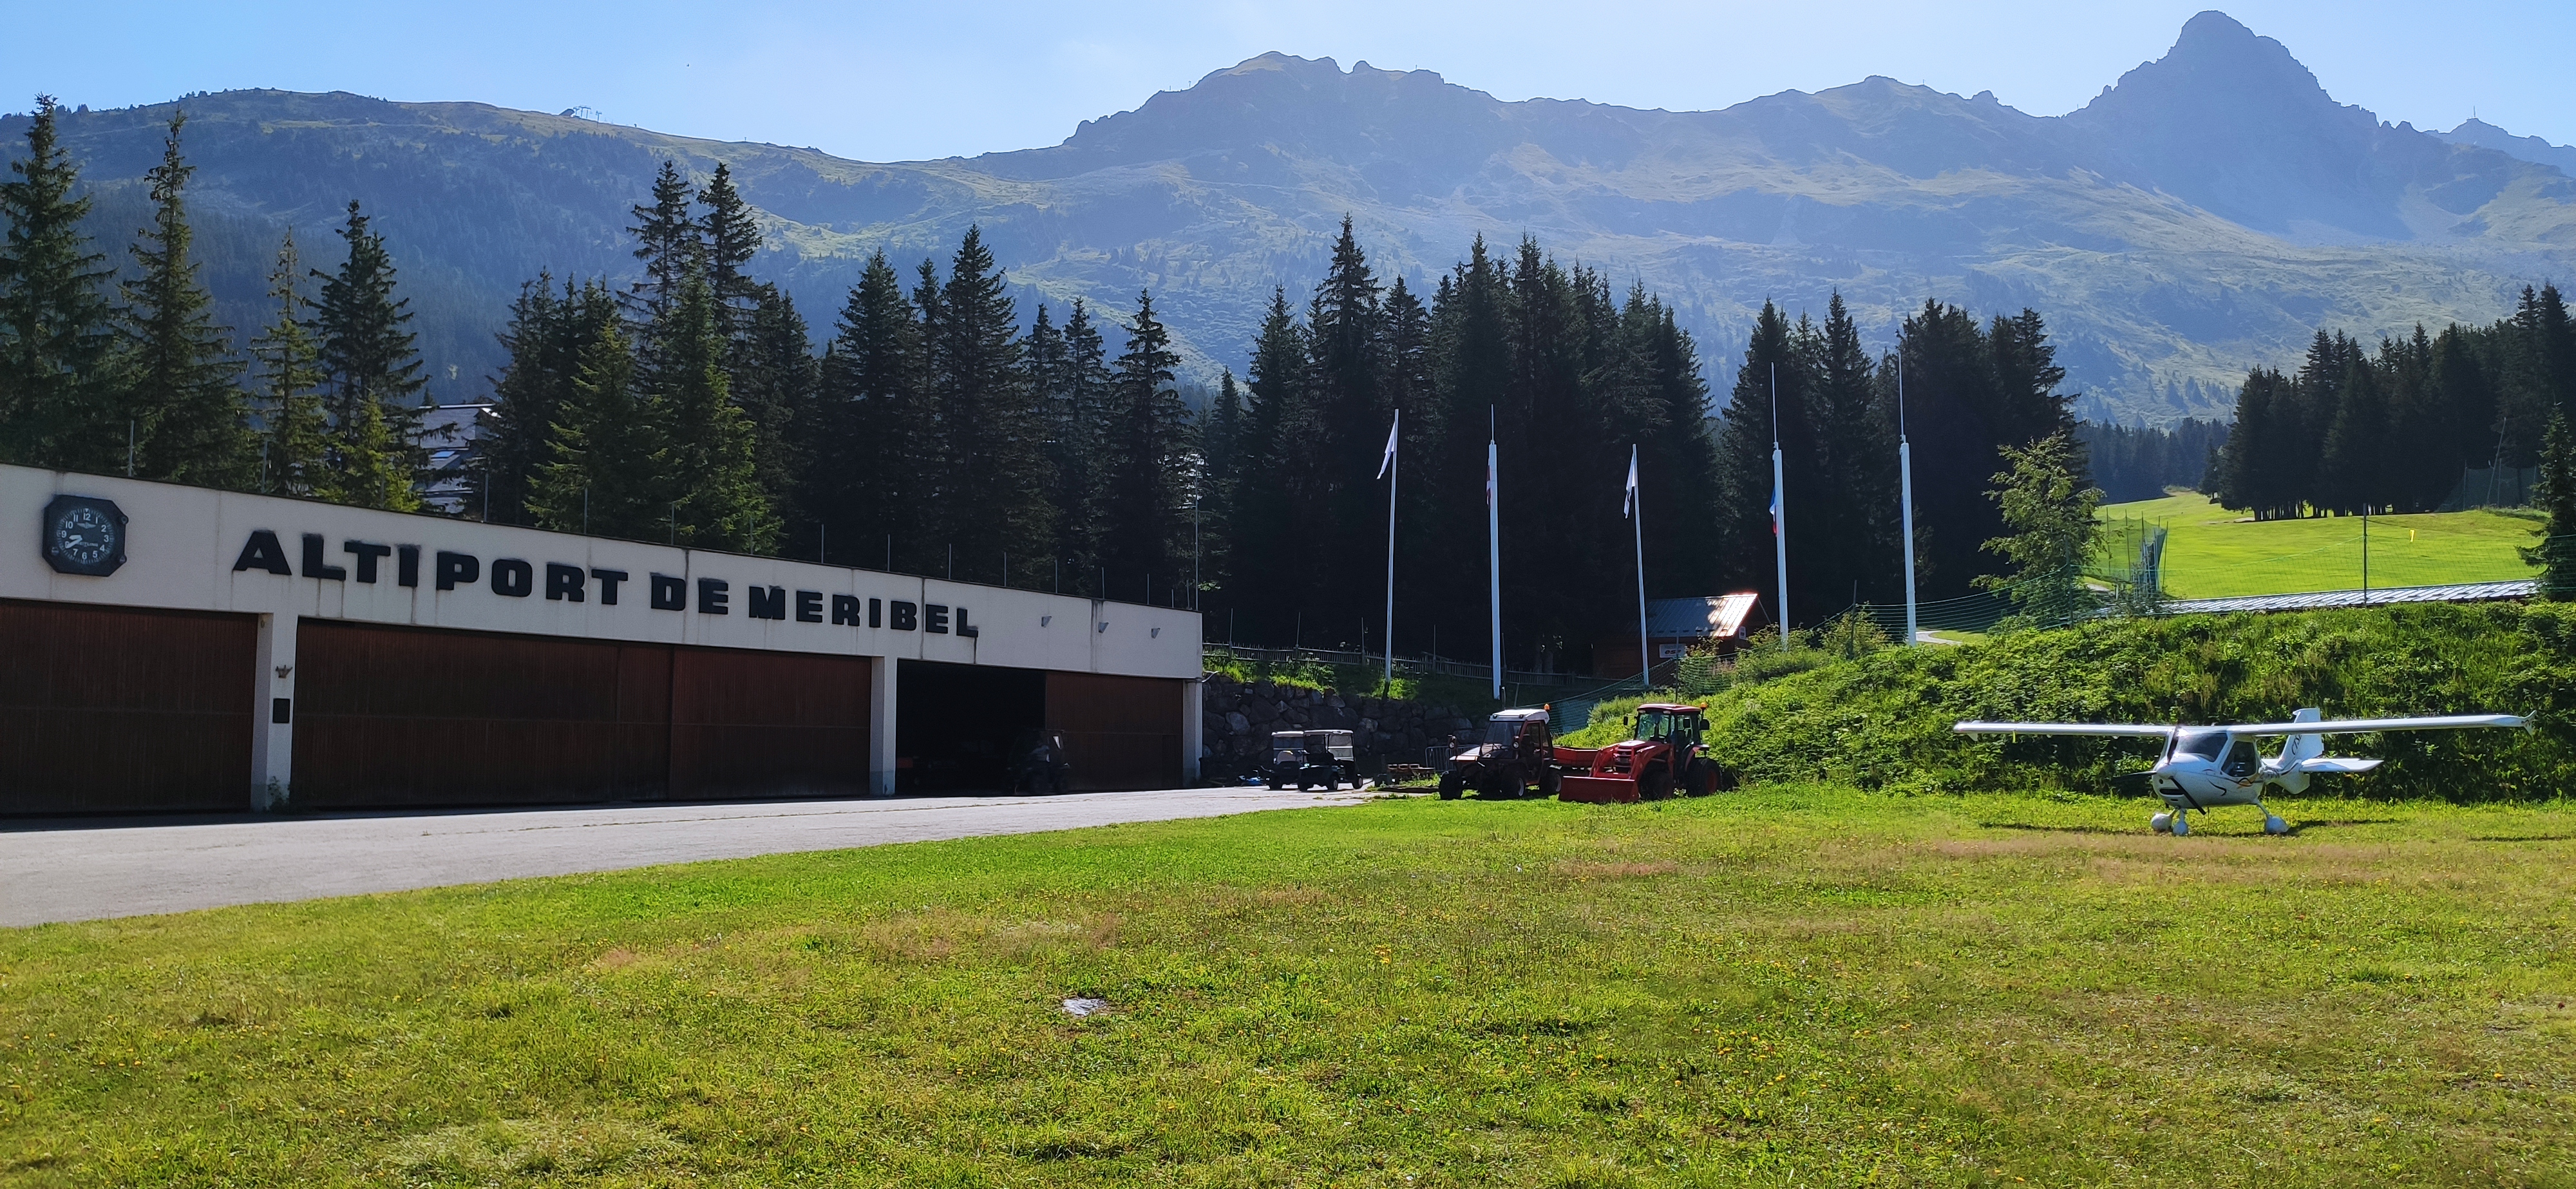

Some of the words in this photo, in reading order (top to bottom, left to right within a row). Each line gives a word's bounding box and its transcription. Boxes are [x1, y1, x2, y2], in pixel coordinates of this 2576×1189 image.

[73, 514, 79, 522] 11
[83, 513, 91, 521] 12
[65, 520, 73, 529] 10
[232, 530, 629, 605] ALTIPORT
[650, 574, 729, 615] DE
[748, 585, 978, 638] MERIBEL
